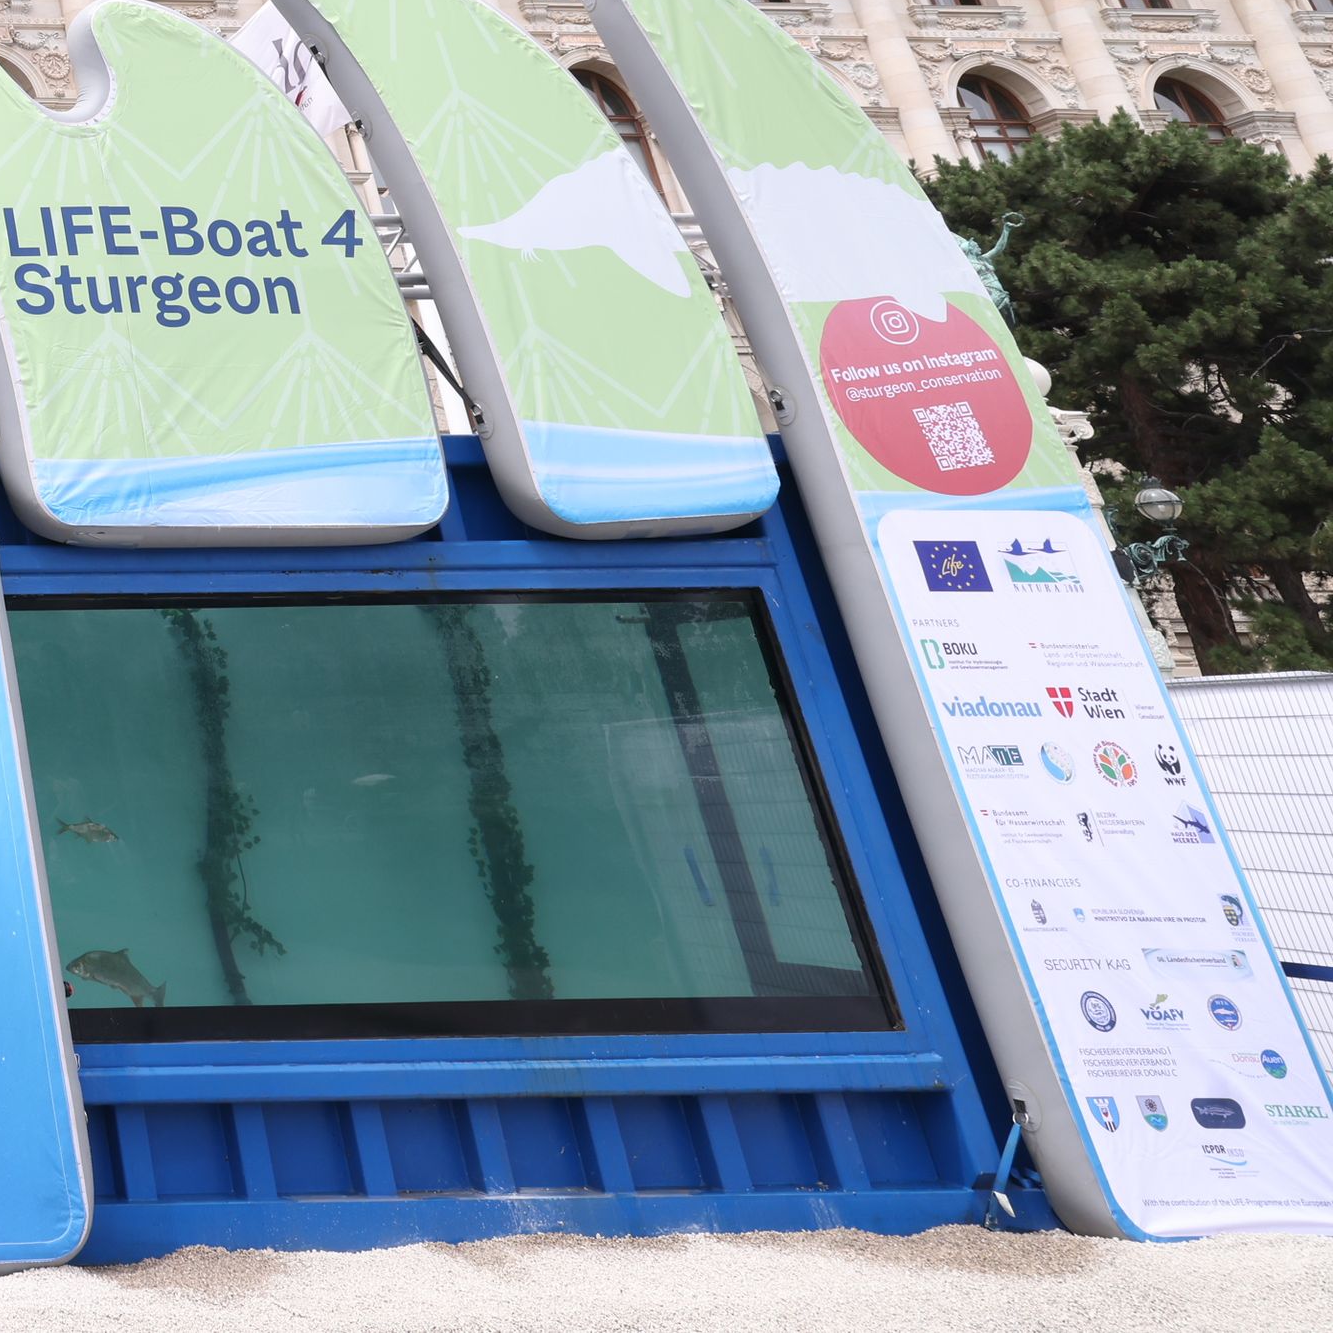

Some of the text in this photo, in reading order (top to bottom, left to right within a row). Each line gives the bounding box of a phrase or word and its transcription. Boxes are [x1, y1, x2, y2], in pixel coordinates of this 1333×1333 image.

[2, 206, 364, 258] LIFE-Boat 4
[13, 262, 301, 329] Sturgeon
[830, 348, 998, 384] Follow us on Instagram
[845, 367, 1002, 402] @sturgeon_conservation
[941, 554, 965, 577] Life
[1013, 584, 1060, 593] NATURA
[912, 619, 960, 628] PARTNERS
[942, 642, 979, 655] BOKU
[1077, 687, 1119, 702] Stadt
[942, 696, 1042, 717] viadonau
[1083, 704, 1126, 719] Wien
[1164, 777, 1187, 786] WWF
[992, 809, 1029, 817] Bundesamt
[1005, 878, 1081, 888] CO-FINANCIERS
[1044, 958, 1131, 971] SECURITY KAG
[1231, 1053, 1284, 1064] Donau Auen
[1144, 1069, 1171, 1077] DONAU
[1264, 1104, 1329, 1119] STARKL
[1201, 1145, 1226, 1154] ICPDR
[1142, 1198, 1158, 1206] With
[1159, 1198, 1170, 1206] the
[1171, 1198, 1211, 1206] contribution
[1212, 1198, 1218, 1206] of
[1218, 1198, 1230, 1206] the
[1231, 1199, 1283, 1208] LIFE-Programme
[1290, 1199, 1300, 1207] the
[1301, 1199, 1331, 1208] European
